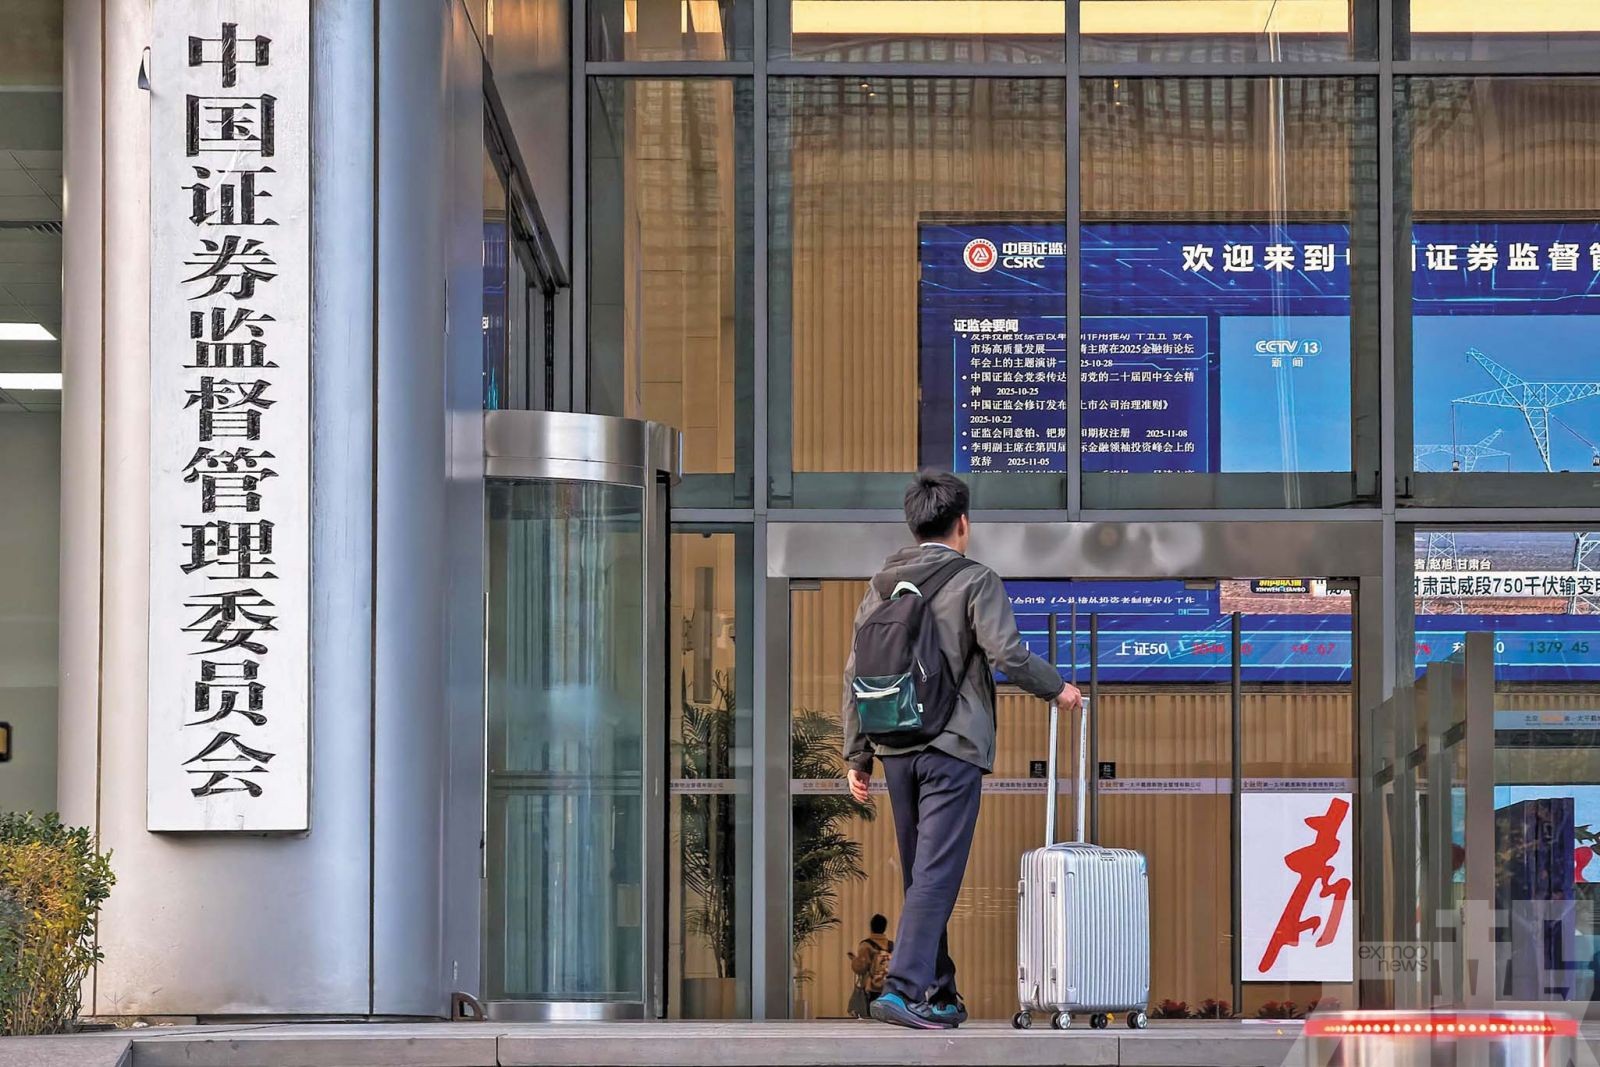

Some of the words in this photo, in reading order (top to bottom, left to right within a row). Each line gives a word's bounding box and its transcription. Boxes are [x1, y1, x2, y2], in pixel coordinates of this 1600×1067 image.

[1002, 242, 1066, 255] 中国证监
[1003, 257, 1045, 269] CSRC
[1182, 242, 1600, 272] 欢迎来到证券监督
[953, 318, 1019, 332] 证监会要闻
[1255, 340, 1299, 353] CCTV
[1303, 342, 1319, 353] 13
[971, 358, 1057, 368] 年会上的主题演讲
[971, 385, 982, 396] 神
[997, 387, 1039, 395] 2025-10-25
[180, 22, 280, 798] 中国证券监督管理委员会
[1146, 430, 1188, 438] 2025-11-08
[970, 456, 992, 466] 致辞
[1008, 458, 1050, 466] 2025-11-05
[1457, 558, 1491, 570] 甘肃台
[1414, 576, 1600, 596] 肃武威段750千伏输变
[1116, 642, 1167, 656] 上证50
